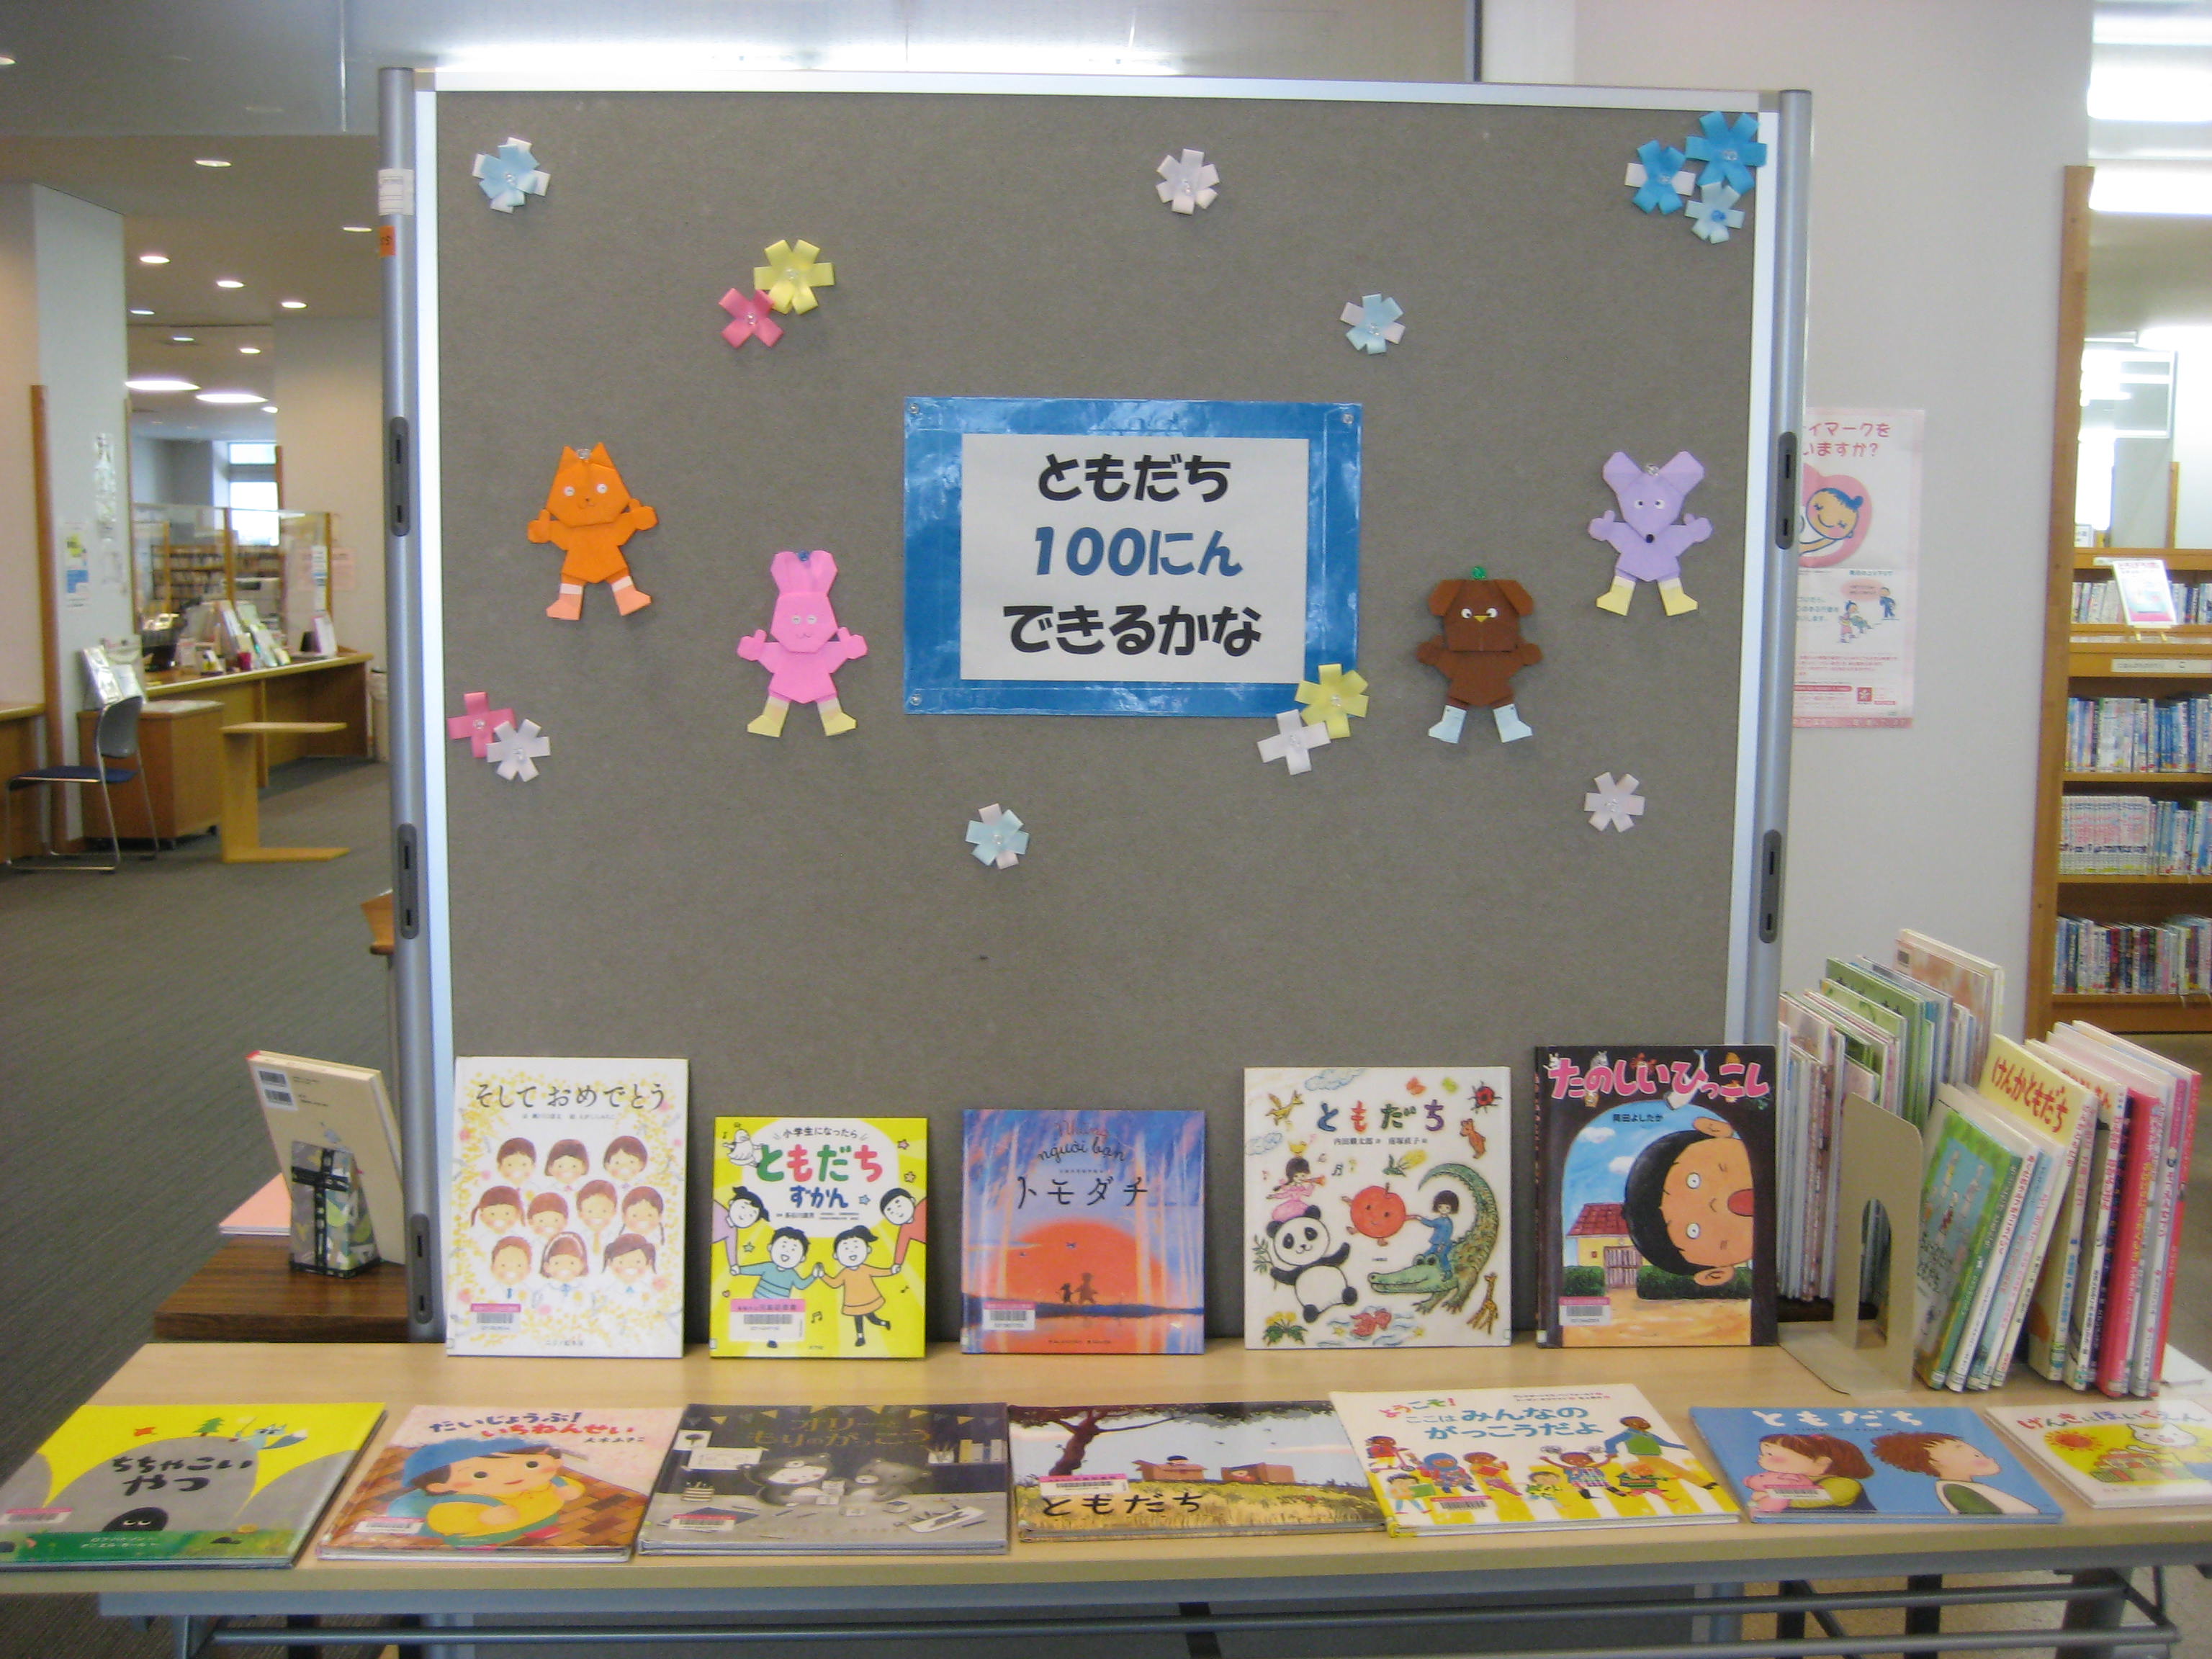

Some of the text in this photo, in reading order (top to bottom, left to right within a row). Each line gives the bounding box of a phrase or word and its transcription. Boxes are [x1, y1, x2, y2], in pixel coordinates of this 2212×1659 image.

[1803, 422, 1891, 437] ィマークを
[1038, 453, 1231, 502] ともだち
[1034, 526, 1243, 575] 100にん
[1003, 603, 1262, 655] できるかな
[1547, 1056, 1770, 1100] たのしいひっこし
[1992, 1056, 2069, 1133] けんかともだち
[1317, 1099, 1444, 1133] ともだち
[783, 1125, 858, 1138] 小学生になったら
[756, 1143, 884, 1182] ともだち
[789, 1184, 849, 1208] ずかん
[1017, 1175, 1148, 1210] トモダチ
[1378, 1398, 1457, 1418] ようこそ!
[1751, 1410, 1923, 1427] ともだち
[429, 1412, 583, 1433] だいじょうぶ!
[480, 1424, 634, 1437] いちねんせい
[1424, 1421, 1604, 1440] がっこうだよ
[122, 1474, 210, 1496] やつ
[1042, 1491, 1203, 1517] ともだち
